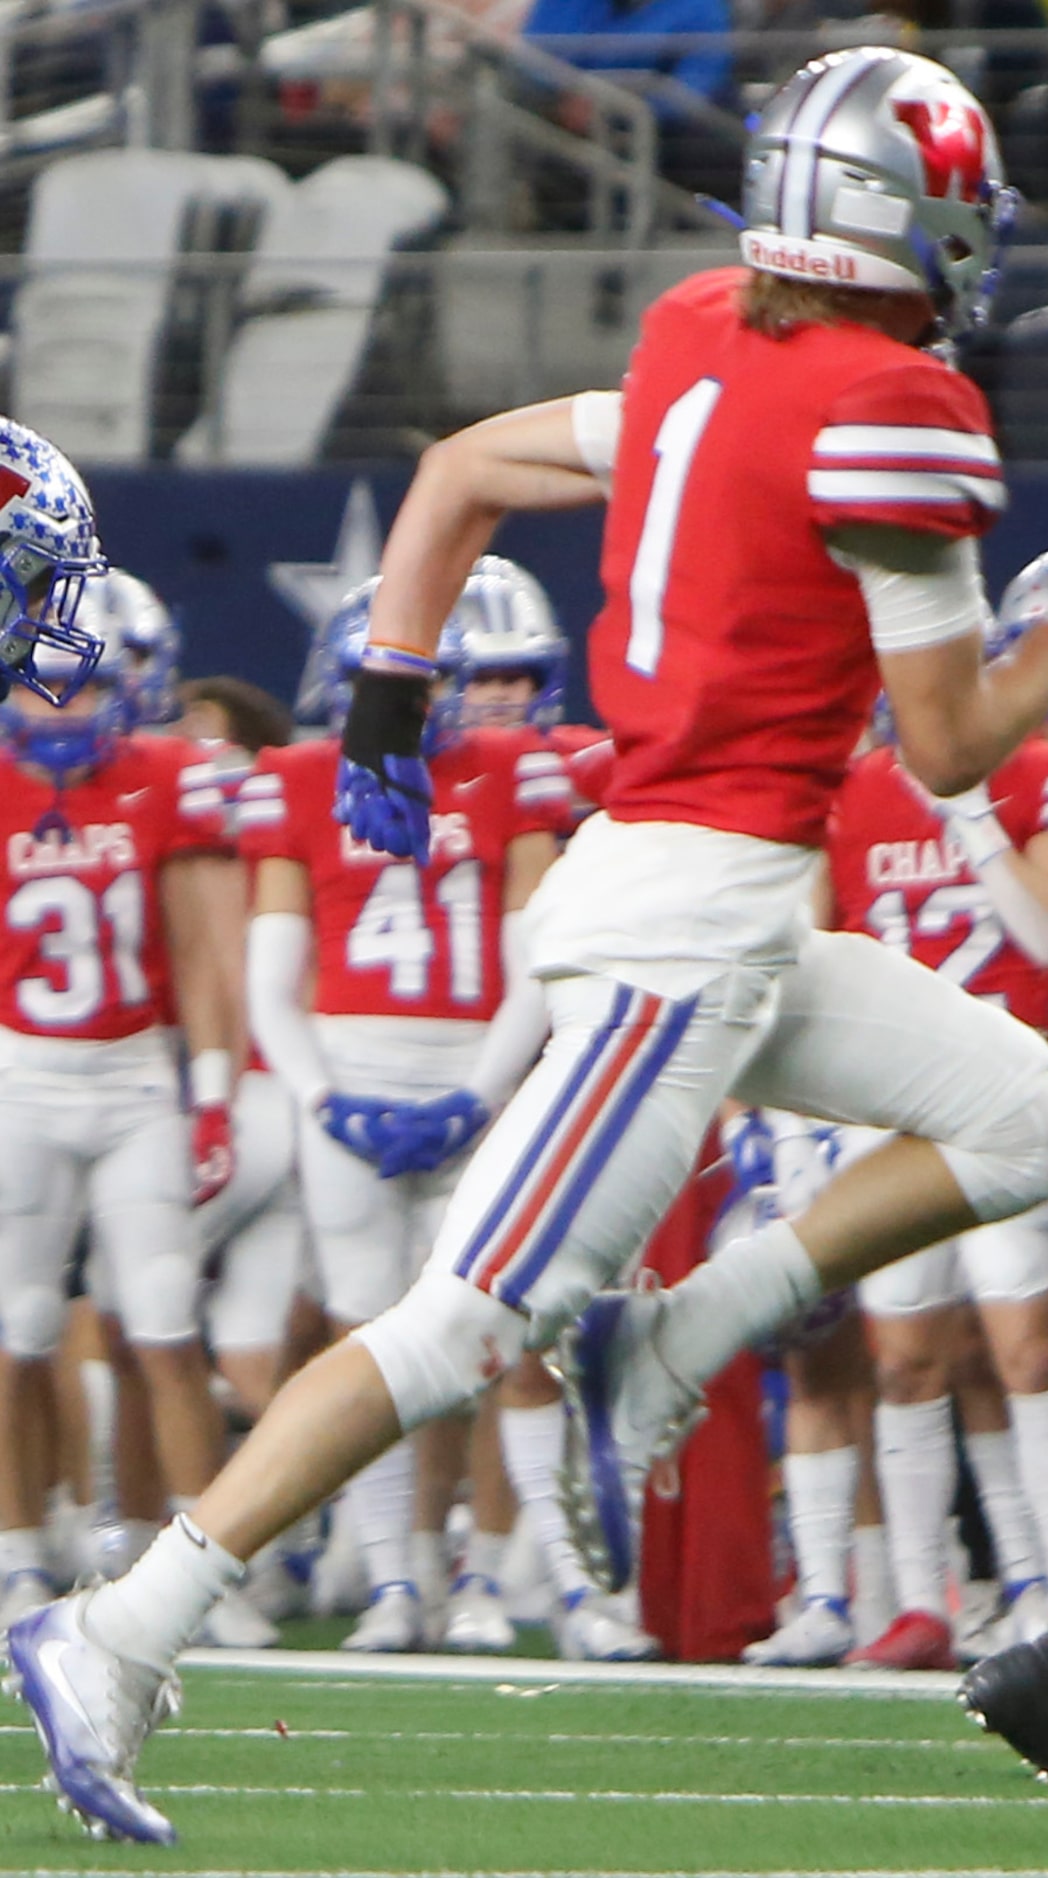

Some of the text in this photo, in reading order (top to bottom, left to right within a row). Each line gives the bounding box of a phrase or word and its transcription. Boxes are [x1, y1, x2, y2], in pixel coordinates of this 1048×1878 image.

[750, 239, 857, 281] Riddell
[626, 375, 724, 681] 1
[6, 868, 149, 1026] 31
[347, 858, 483, 1002] 41
